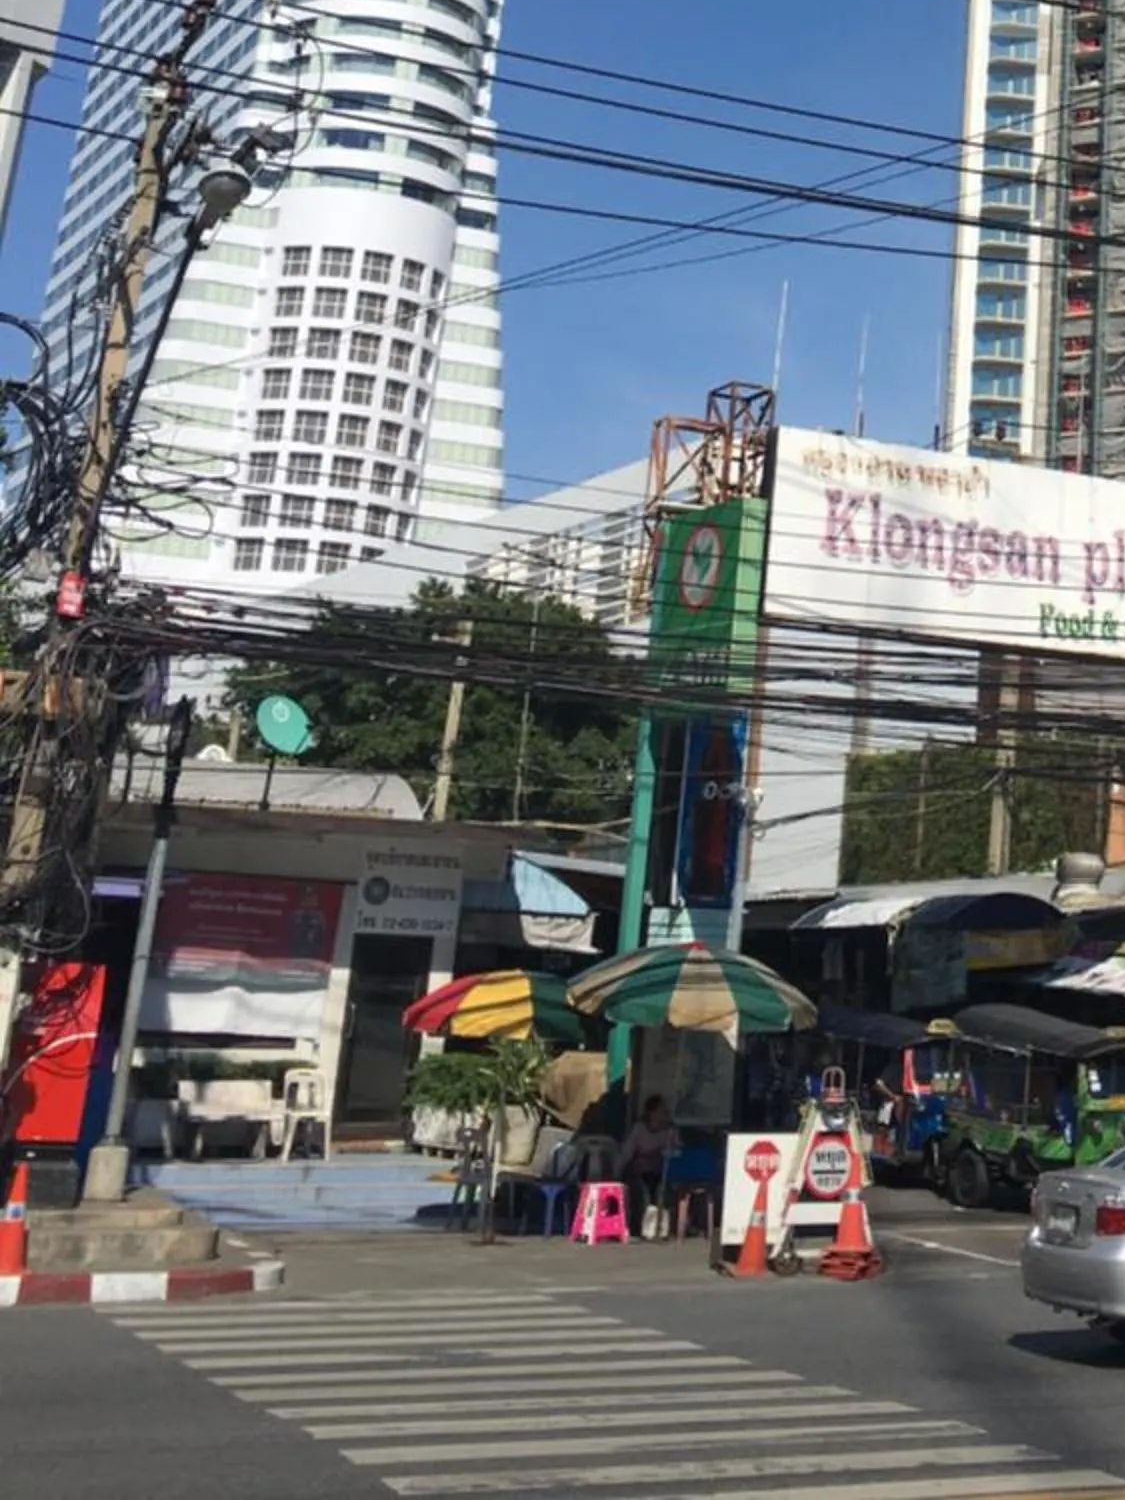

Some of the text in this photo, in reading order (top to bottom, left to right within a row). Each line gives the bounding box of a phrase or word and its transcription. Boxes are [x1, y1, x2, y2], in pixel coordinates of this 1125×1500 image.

[821, 488, 1060, 595] Klongsan
[1040, 603, 1095, 639] Food
[1102, 611, 1119, 638] &
